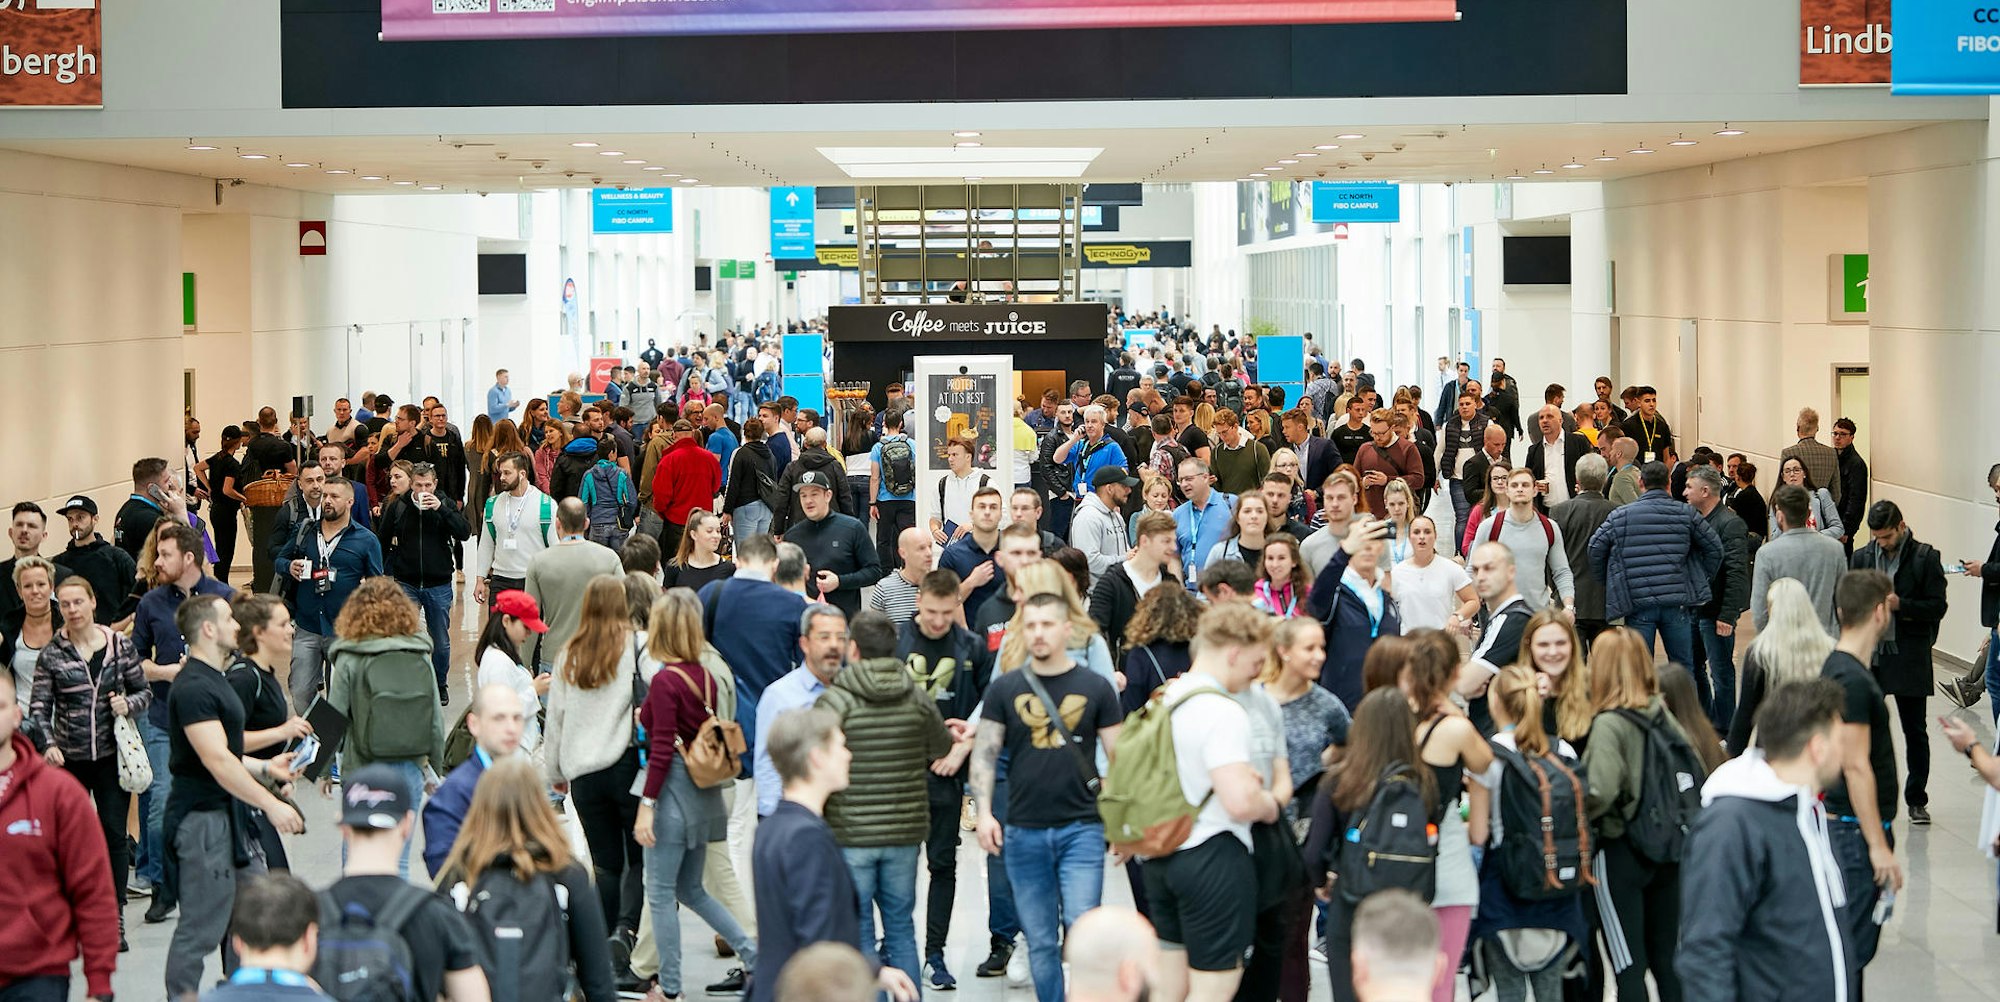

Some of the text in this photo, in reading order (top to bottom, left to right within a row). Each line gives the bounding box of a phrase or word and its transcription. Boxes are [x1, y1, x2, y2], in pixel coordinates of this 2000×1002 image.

[1973, 8, 1999, 23] CC
[1806, 23, 1893, 54] Lindb
[1957, 35, 2000, 52] FIBO
[887, 310, 947, 338] Coffee
[950, 320, 980, 332] meets
[946, 378, 977, 391] PROTEIN
[938, 392, 949, 404] AT
[966, 391, 985, 404] BEST
